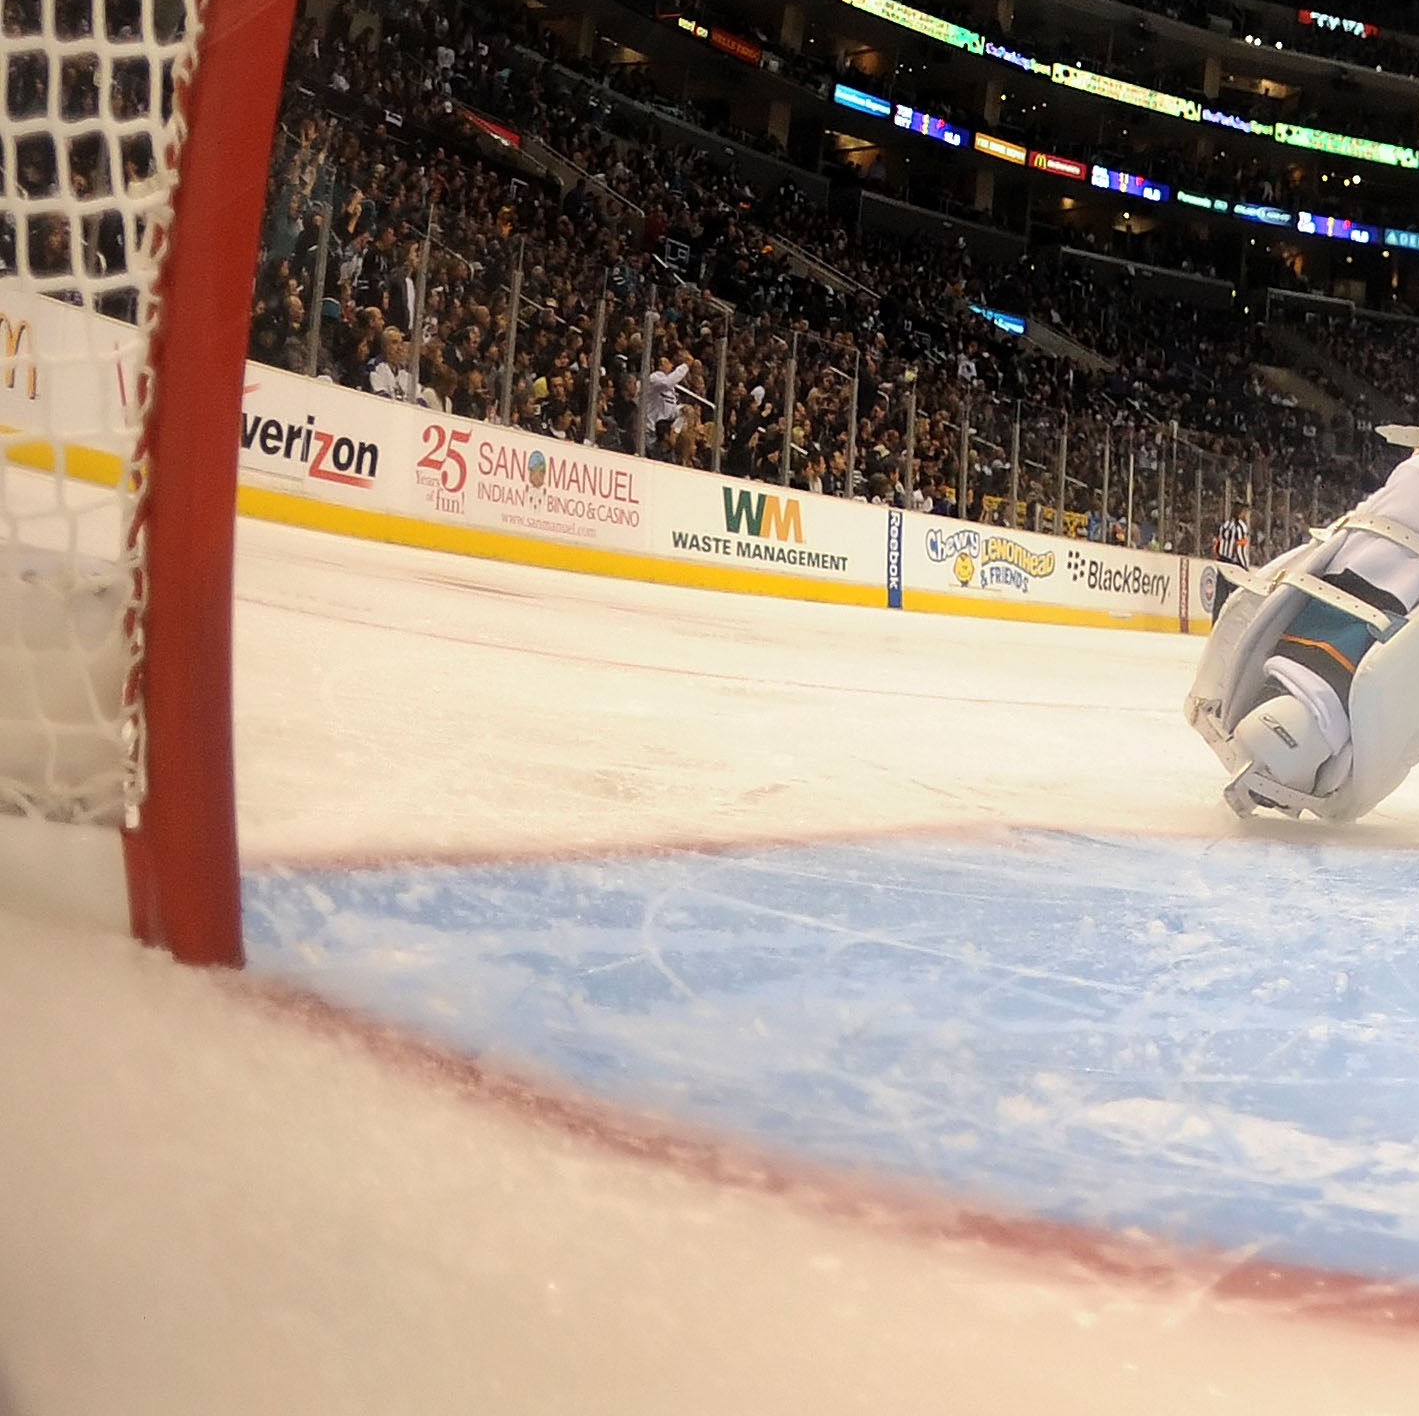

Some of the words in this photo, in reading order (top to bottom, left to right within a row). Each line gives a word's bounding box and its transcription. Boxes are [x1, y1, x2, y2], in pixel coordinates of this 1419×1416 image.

[241, 414, 379, 488] verizon
[417, 424, 472, 493] 25
[478, 441, 527, 482] SAN
[549, 456, 640, 504] MANUEL
[435, 488, 465, 515] fun!
[478, 482, 525, 508] INDIAN
[547, 494, 585, 519] BINGO
[586, 504, 596, 519] &
[597, 504, 640, 528] CASINO
[723, 486, 802, 543] WM
[672, 530, 731, 557] WASTE
[736, 541, 848, 572] MANAGEMENT
[888, 511, 900, 591] Reebok
[926, 529, 981, 562] Chewy
[990, 567, 1029, 594] FRIENDS
[1088, 561, 1171, 605] BlackBerry
